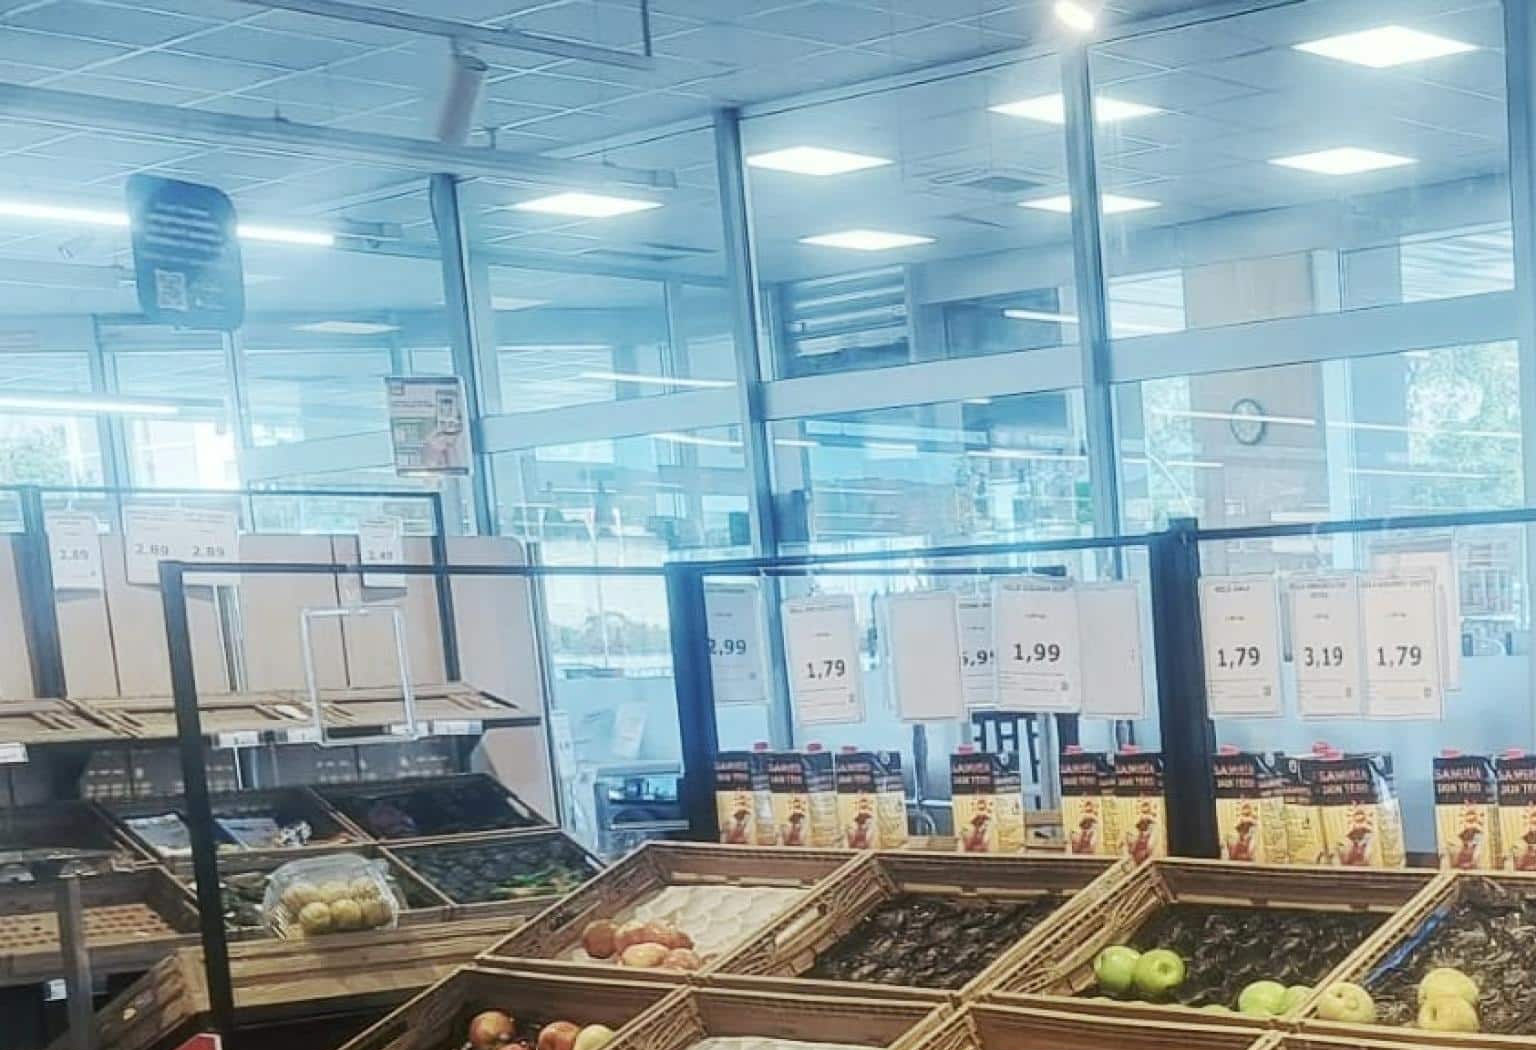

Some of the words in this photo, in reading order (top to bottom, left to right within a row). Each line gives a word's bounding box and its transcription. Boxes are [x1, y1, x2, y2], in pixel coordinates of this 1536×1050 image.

[1013, 643, 1061, 664] 1,99
[1217, 646, 1261, 669] 1,79
[1304, 646, 1343, 668] 3,19
[1377, 645, 1422, 668] 1,79
[806, 659, 846, 680] 1,79
